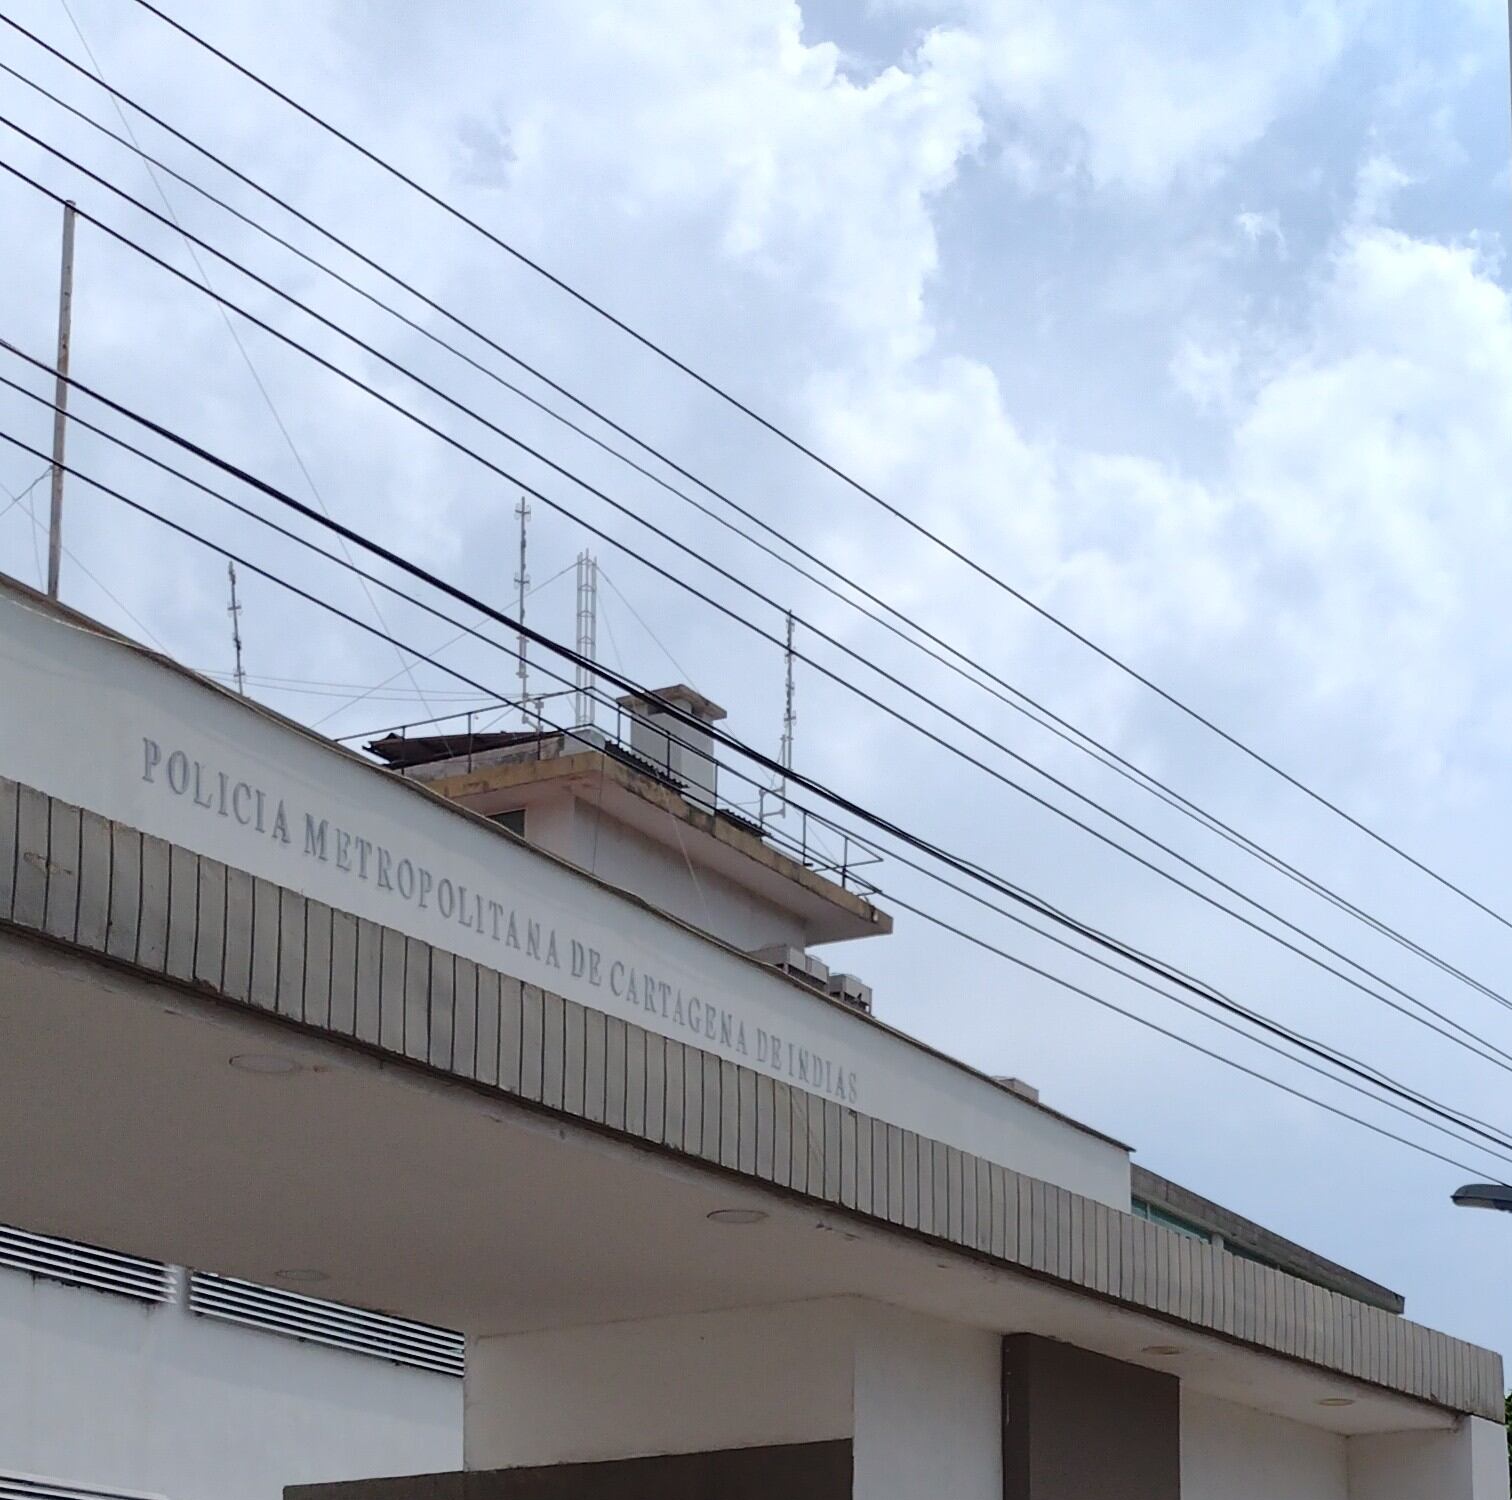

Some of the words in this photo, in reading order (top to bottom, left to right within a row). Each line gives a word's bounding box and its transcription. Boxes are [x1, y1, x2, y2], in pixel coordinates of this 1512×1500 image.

[142, 737, 291, 844] POLICIA
[304, 812, 560, 969] METROPOLITANA
[571, 938, 603, 987] DE
[610, 960, 748, 1056] CARTAGENA
[757, 1027, 782, 1071] DE
[788, 1043, 858, 1104] INDIAS
